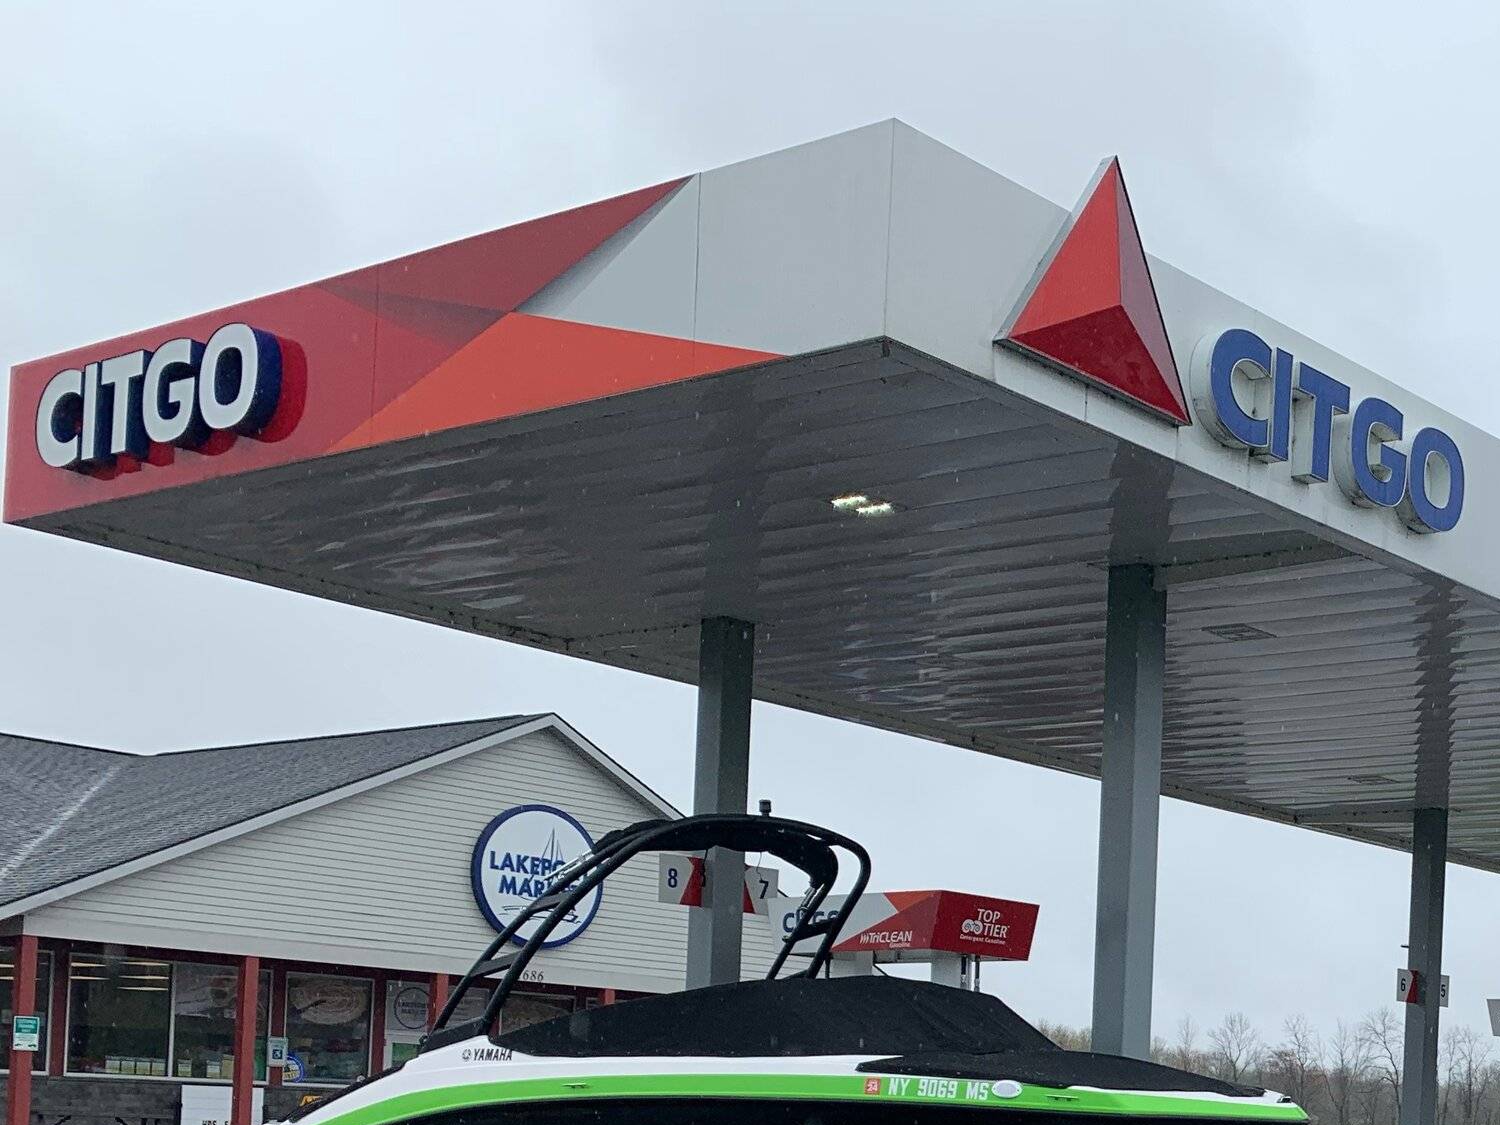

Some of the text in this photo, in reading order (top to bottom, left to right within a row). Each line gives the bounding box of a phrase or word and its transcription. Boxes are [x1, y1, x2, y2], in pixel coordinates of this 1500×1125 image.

[36, 323, 276, 470] CITGO
[1206, 328, 1465, 533] CITGO
[489, 850, 584, 880] LAKEP
[667, 868, 678, 888] 8
[759, 880, 769, 899] 7
[977, 908, 1001, 922] TOP
[983, 924, 1008, 939] TIER
[1400, 978, 1406, 991] 6
[1440, 984, 1446, 998] 5
[474, 1048, 513, 1061] YAMAHA
[888, 1077, 989, 1101] NY 9069 MS
